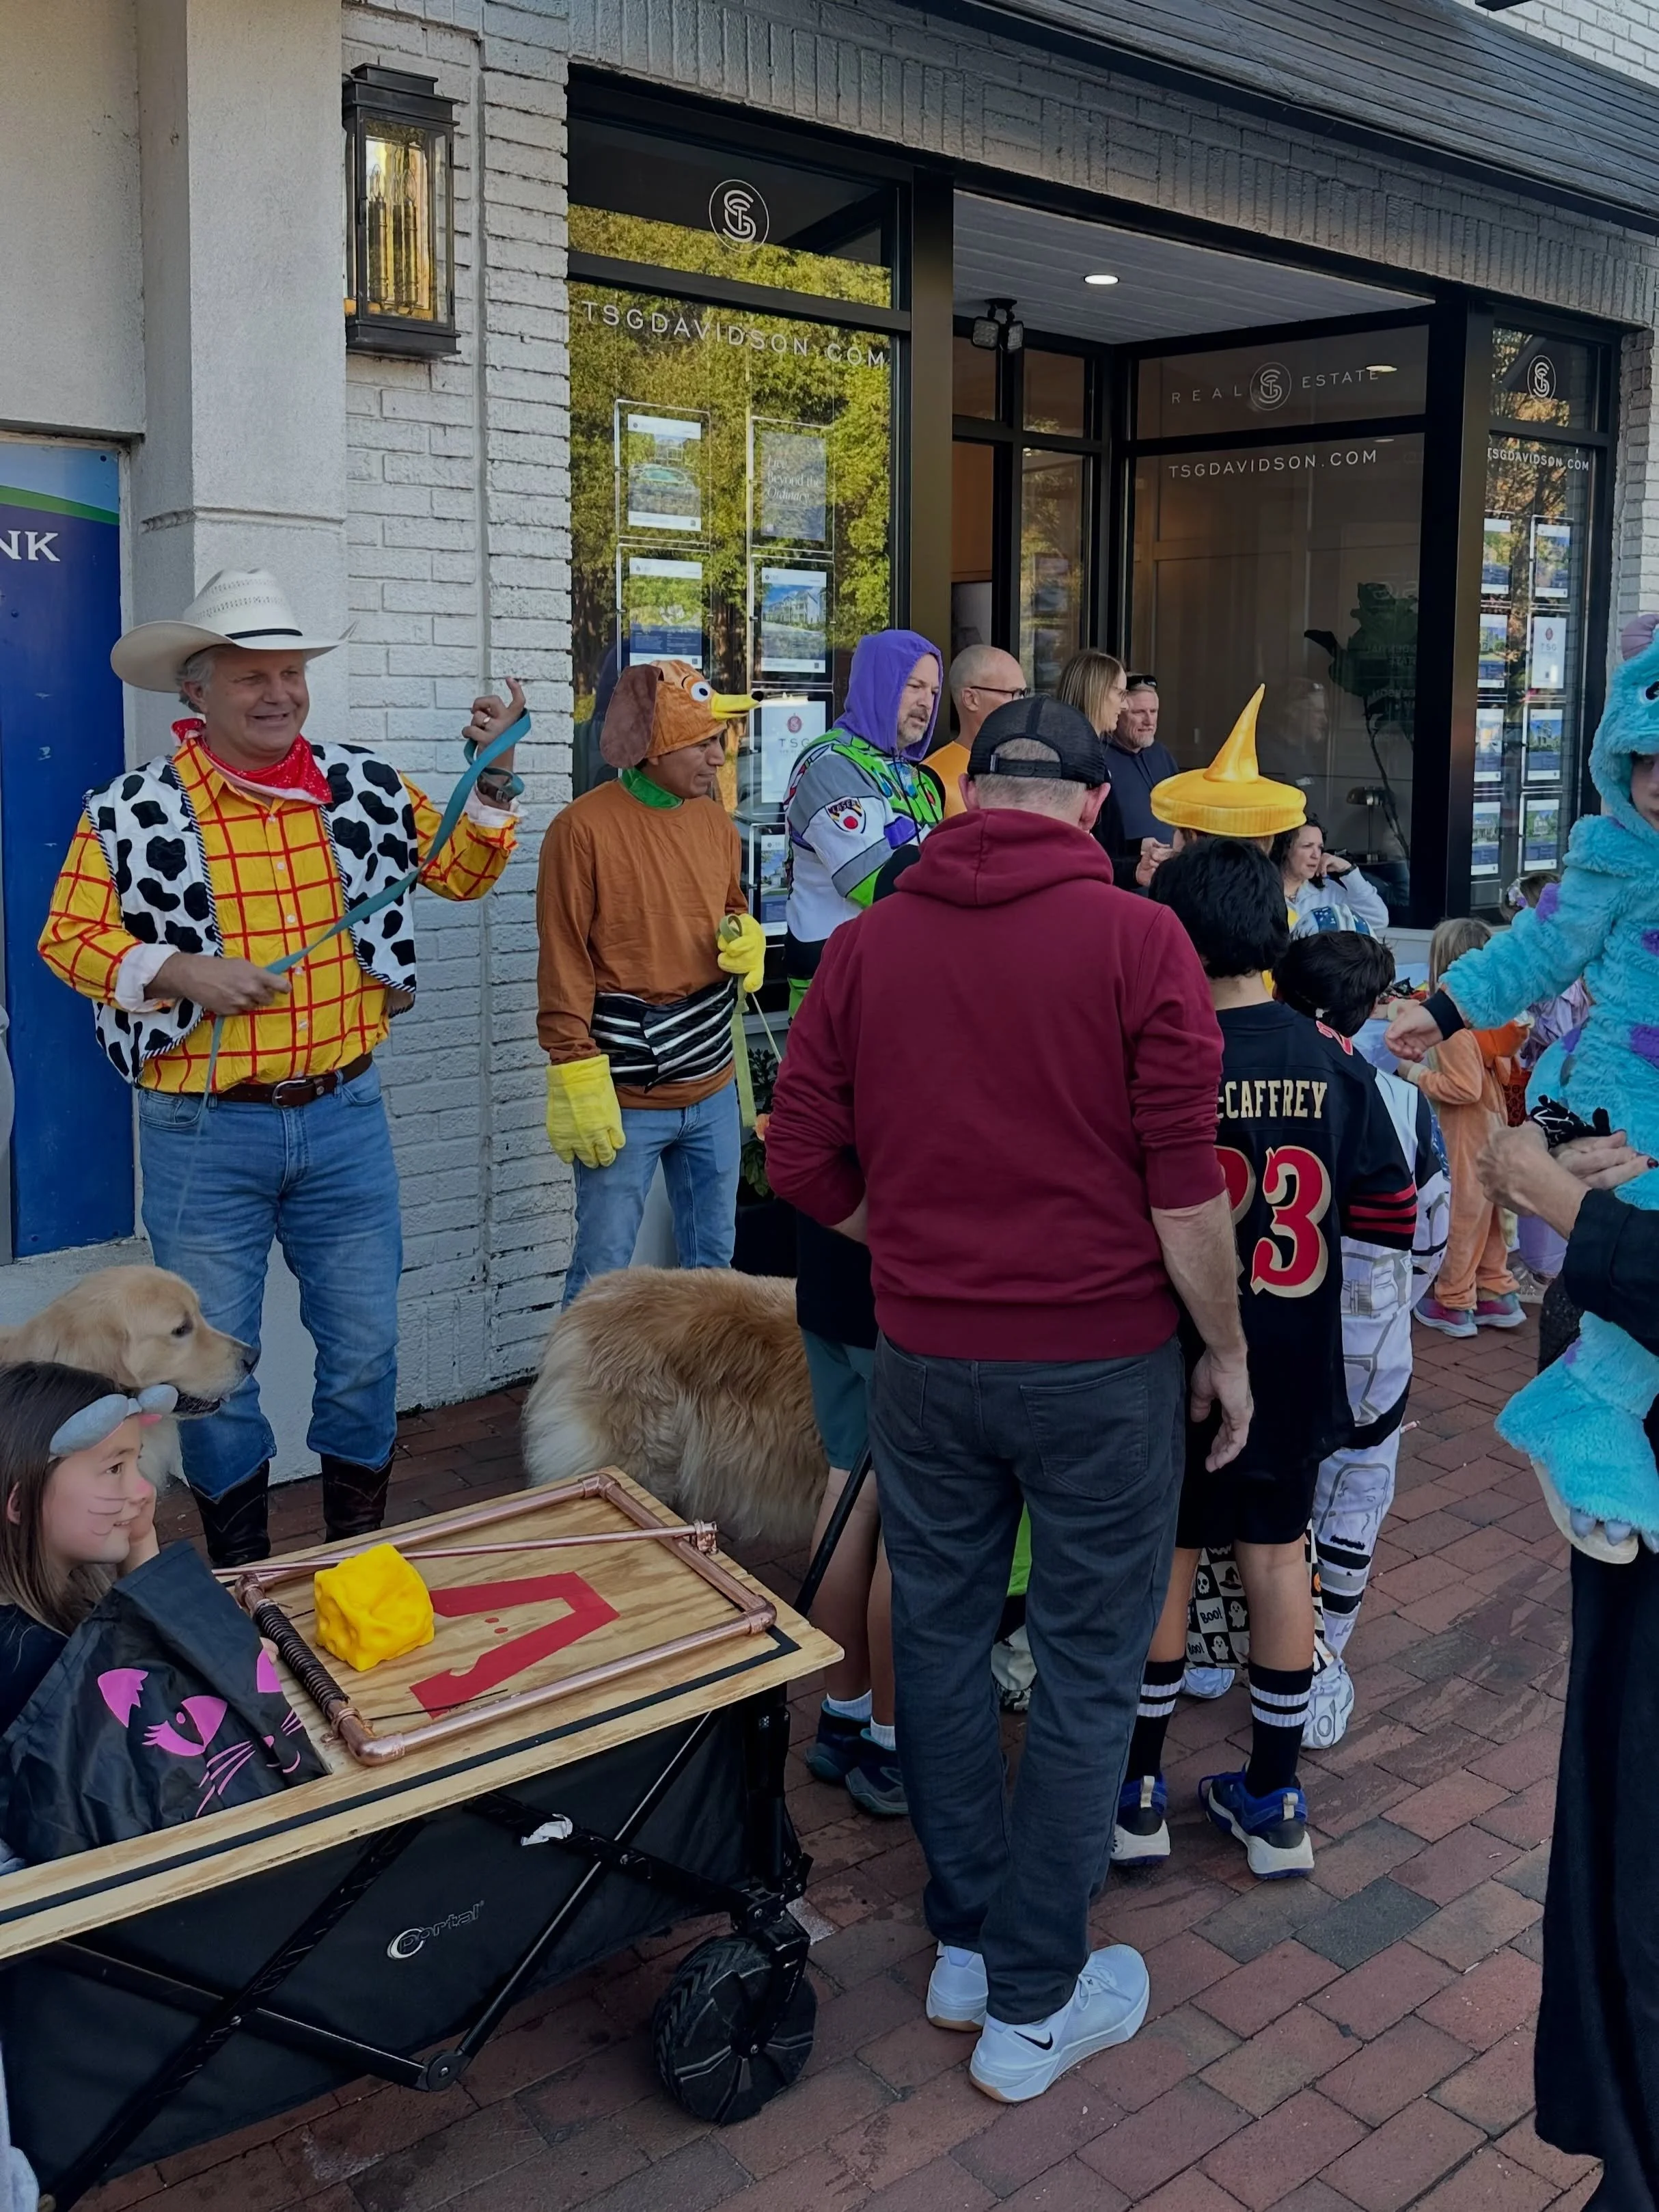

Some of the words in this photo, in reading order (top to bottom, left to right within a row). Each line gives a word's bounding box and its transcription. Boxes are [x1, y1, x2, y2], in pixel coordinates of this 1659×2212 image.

[581, 301, 884, 370] TSGDAVIDSONCOM
[1171, 385, 1243, 405] REAL
[1302, 369, 1379, 389] ESTATE
[1168, 450, 1377, 478] TSGDAVIDSON.COM
